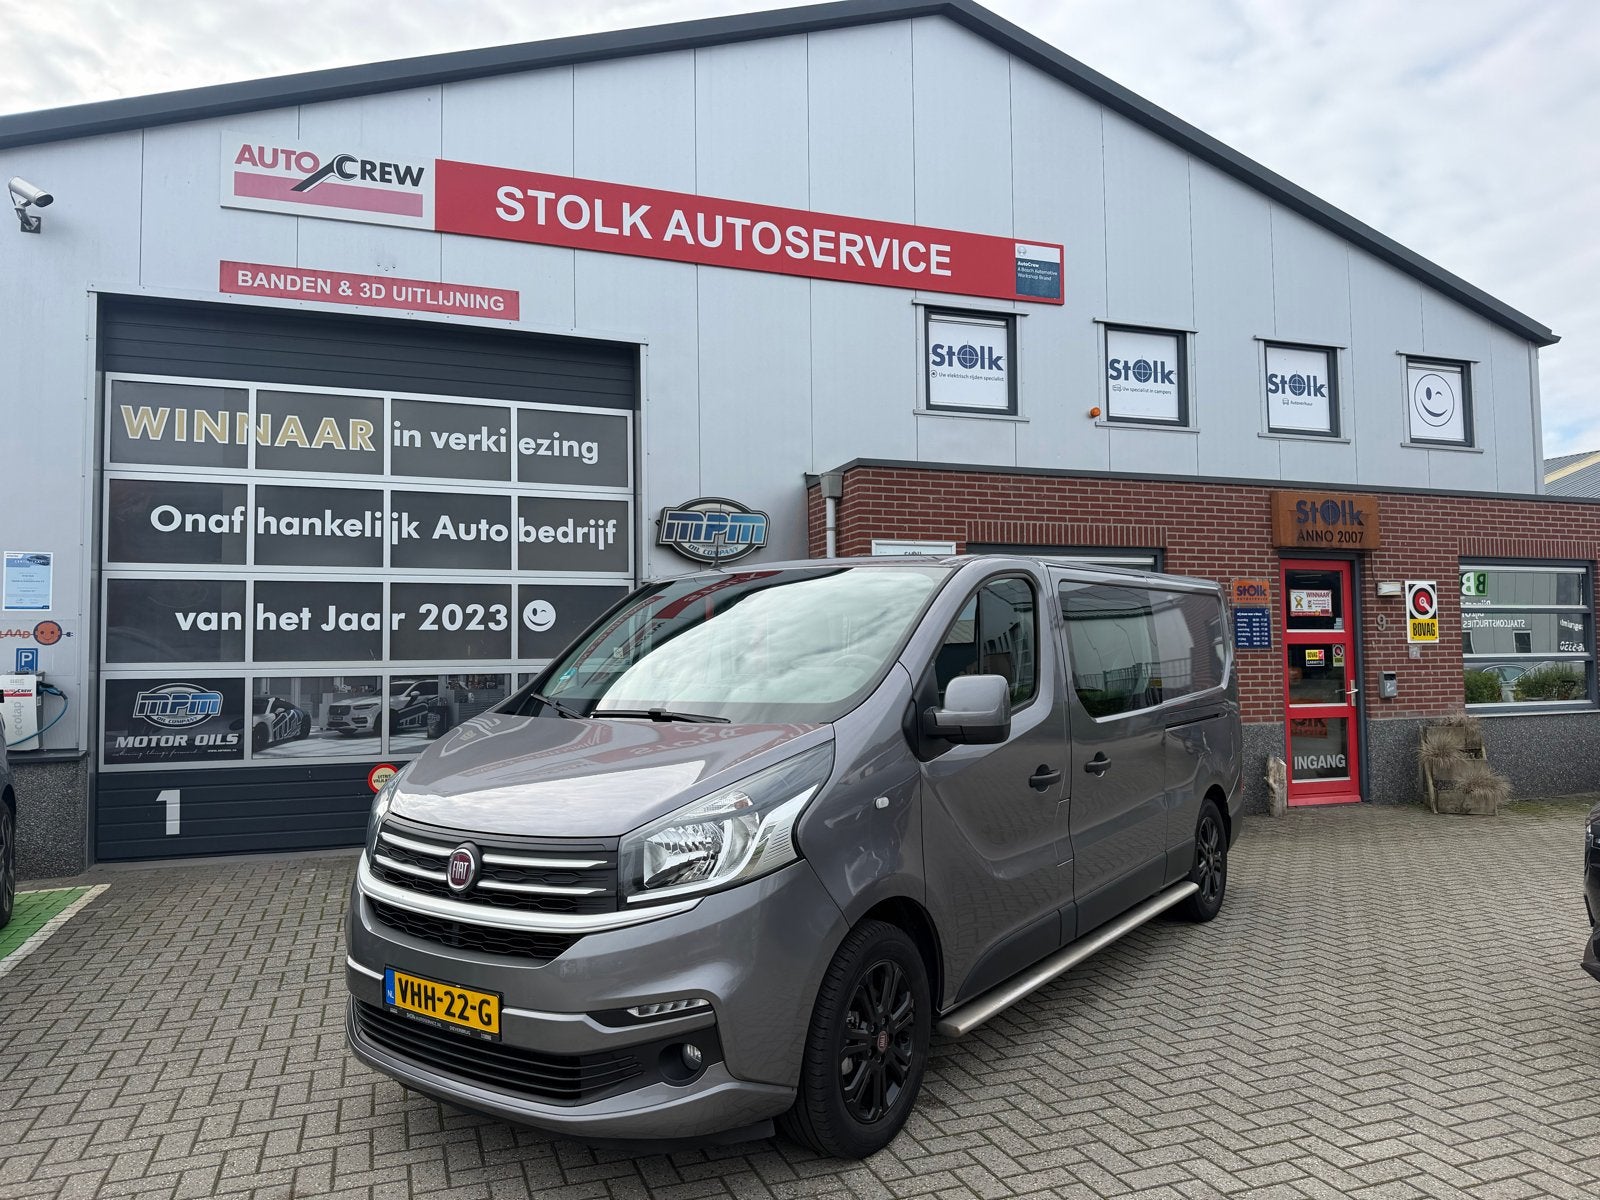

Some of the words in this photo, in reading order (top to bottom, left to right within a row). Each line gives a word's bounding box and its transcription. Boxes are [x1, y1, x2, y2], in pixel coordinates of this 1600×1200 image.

[234, 143, 320, 174] AUTO
[333, 153, 425, 187] CREW
[495, 185, 653, 240] STOLK
[663, 208, 952, 277] AUTOSERVICE
[237, 269, 331, 295] BANDEN
[338, 279, 353, 297] &
[359, 282, 386, 301] 3D
[393, 285, 505, 312] UITLIJNING
[120, 404, 377, 452] WINNAAR
[393, 420, 422, 448] in
[430, 425, 600, 465] verkiezing
[150, 504, 420, 546] Onafhankelijk
[431, 514, 617, 551] Autobedrijf
[1297, 529, 1334, 543] ANNO
[1337, 530, 1364, 544] 2007
[688, 543, 701, 554] OIL
[1306, 591, 1330, 599] WINNAAR
[174, 610, 242, 632] van
[256, 602, 312, 632] het
[320, 604, 406, 632] Jaar
[418, 603, 508, 631] 2023
[1376, 613, 1387, 632] 9
[1412, 622, 1436, 637] BOVAG
[21, 652, 33, 666] P
[115, 734, 188, 748] MOTOR
[194, 733, 239, 746] OILS
[1294, 754, 1346, 770] INGANG
[155, 789, 181, 835] 1
[452, 860, 469, 880] FIAT
[387, 990, 395, 999] NL
[398, 977, 492, 1027] VHH-22-G
